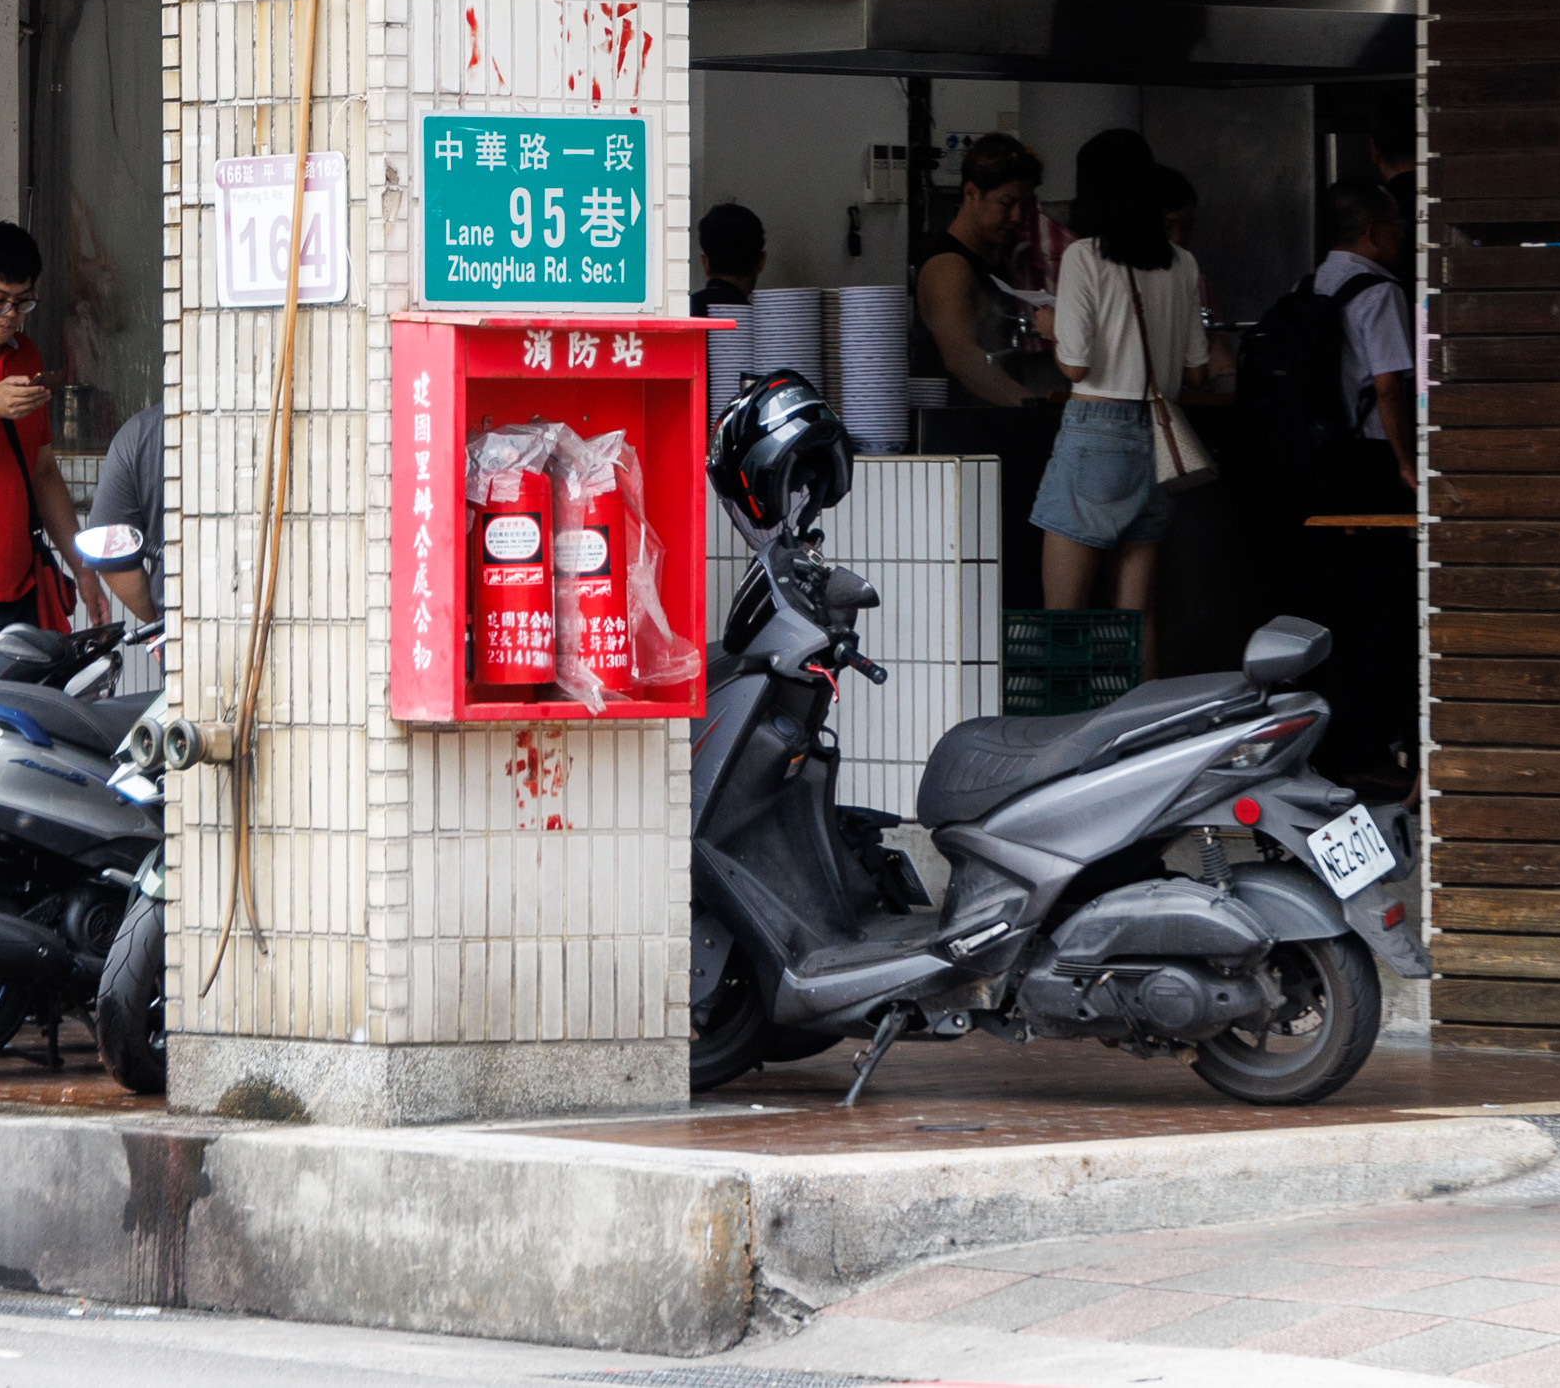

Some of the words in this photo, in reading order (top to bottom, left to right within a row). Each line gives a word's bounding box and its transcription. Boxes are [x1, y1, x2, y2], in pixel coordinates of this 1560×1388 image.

[435, 131, 634, 171] 中華路一段
[445, 219, 494, 246] Lane
[510, 187, 566, 248] 95
[580, 187, 626, 248] 巷
[447, 255, 536, 289] ZhongHua
[544, 256, 572, 283] Rd.
[581, 256, 625, 284] Sec.1
[523, 330, 644, 371] 消防站
